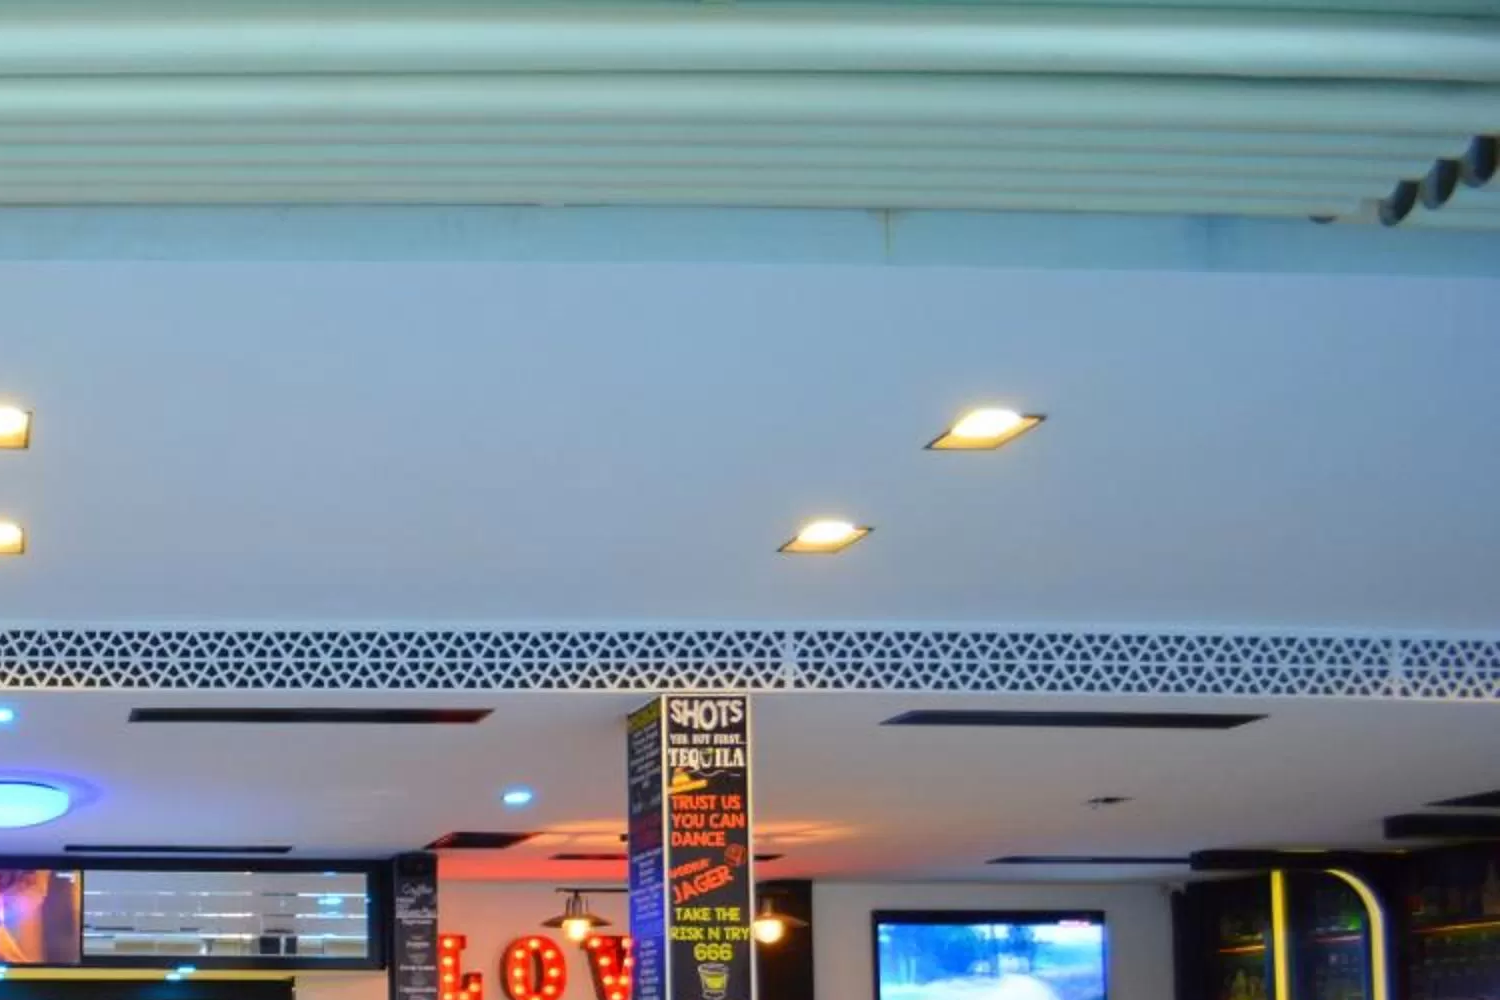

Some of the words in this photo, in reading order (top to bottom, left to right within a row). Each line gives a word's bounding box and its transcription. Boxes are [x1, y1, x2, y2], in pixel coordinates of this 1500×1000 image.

[670, 700, 743, 731] SHOTS
[668, 747, 745, 771] TEQUILA
[671, 795, 716, 810] TRUST
[721, 795, 741, 810] US
[672, 813, 705, 829] YOU
[709, 813, 745, 829] CAN
[671, 831, 725, 847] DANCE
[673, 865, 734, 904] JAGER
[675, 907, 710, 922] TAKE
[714, 907, 740, 922] THE
[670, 926, 704, 941] RISK
[707, 926, 720, 941] N
[723, 926, 750, 941] TRY
[693, 943, 733, 962] 666
